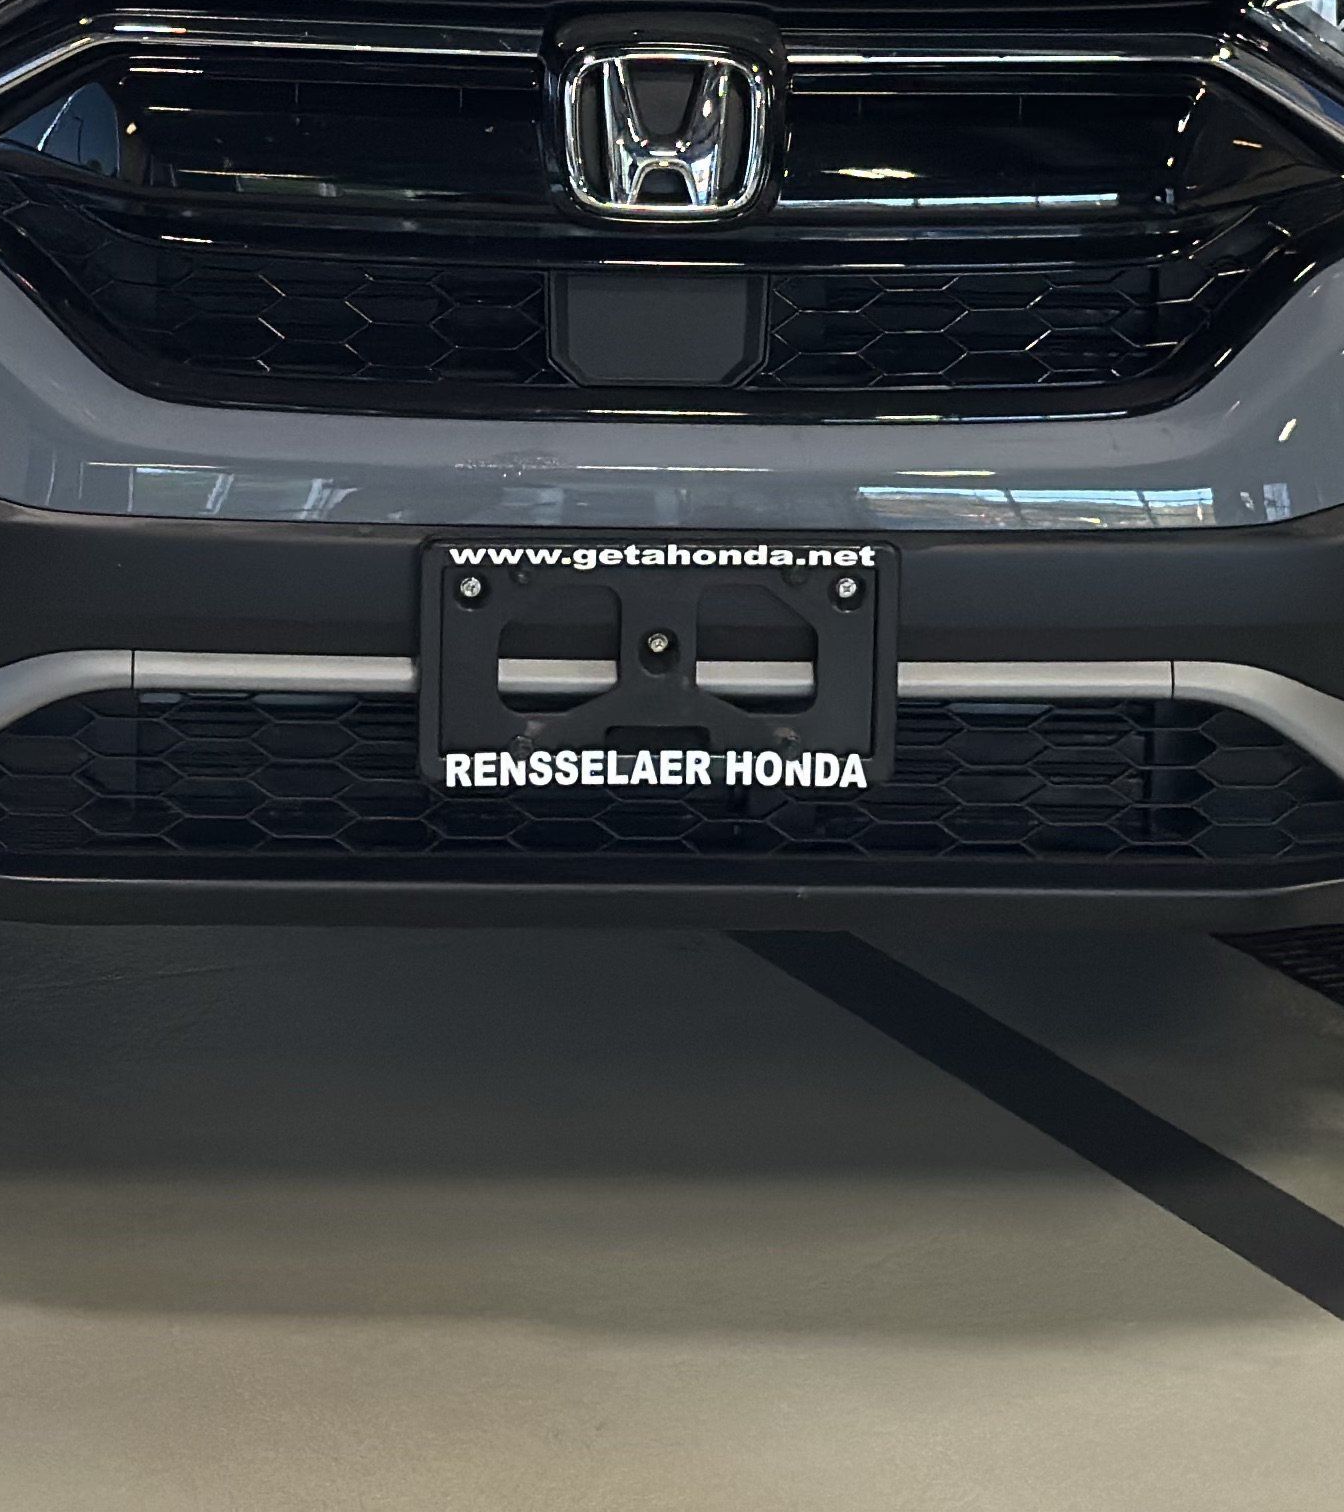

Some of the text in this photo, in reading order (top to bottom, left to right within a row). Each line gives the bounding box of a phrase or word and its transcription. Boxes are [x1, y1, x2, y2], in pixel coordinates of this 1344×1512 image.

[449, 544, 876, 569] www.getahonda.net
[445, 750, 868, 788] RENSSELAER HONDA
